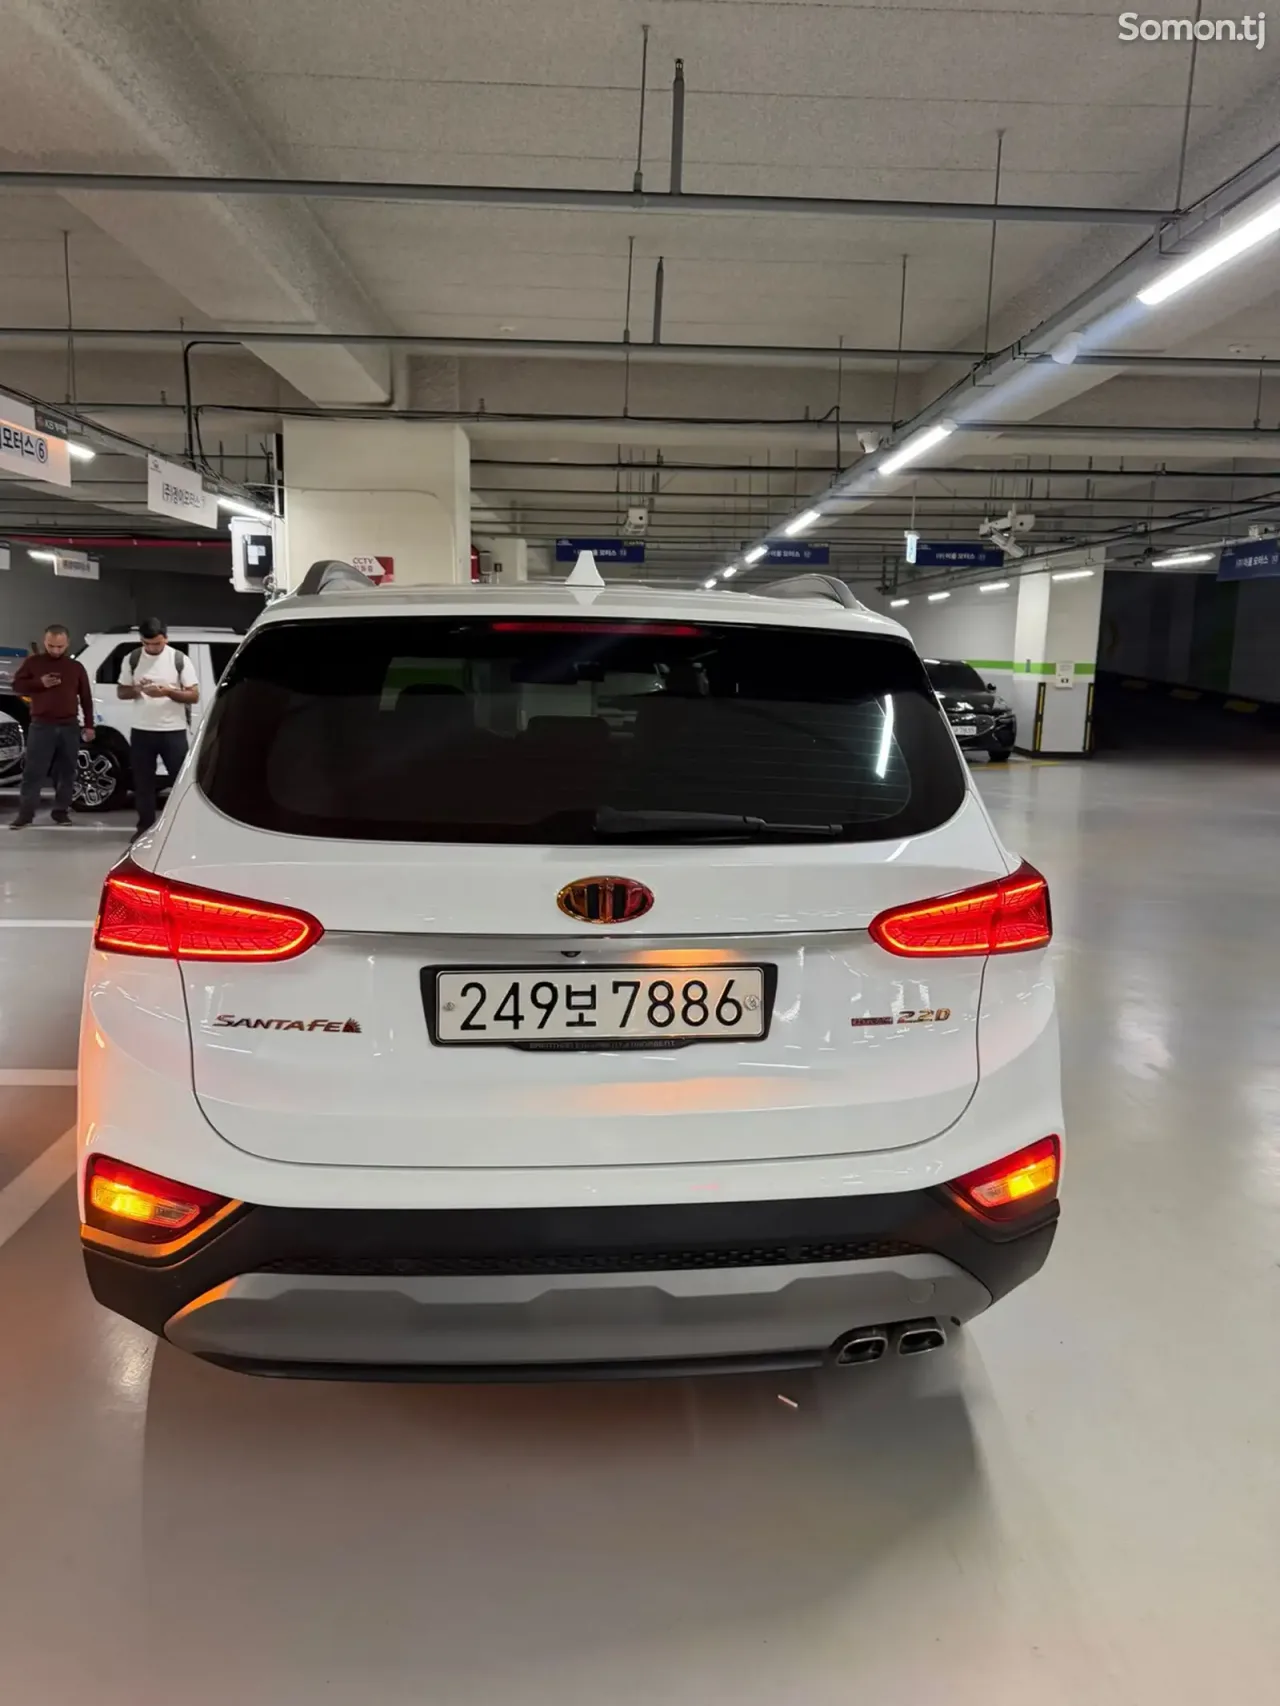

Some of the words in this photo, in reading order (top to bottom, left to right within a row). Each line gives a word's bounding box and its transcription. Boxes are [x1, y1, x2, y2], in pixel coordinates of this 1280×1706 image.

[0, 427, 35, 457] 모터스
[459, 981, 597, 1031] 249보
[612, 979, 743, 1028] 7886
